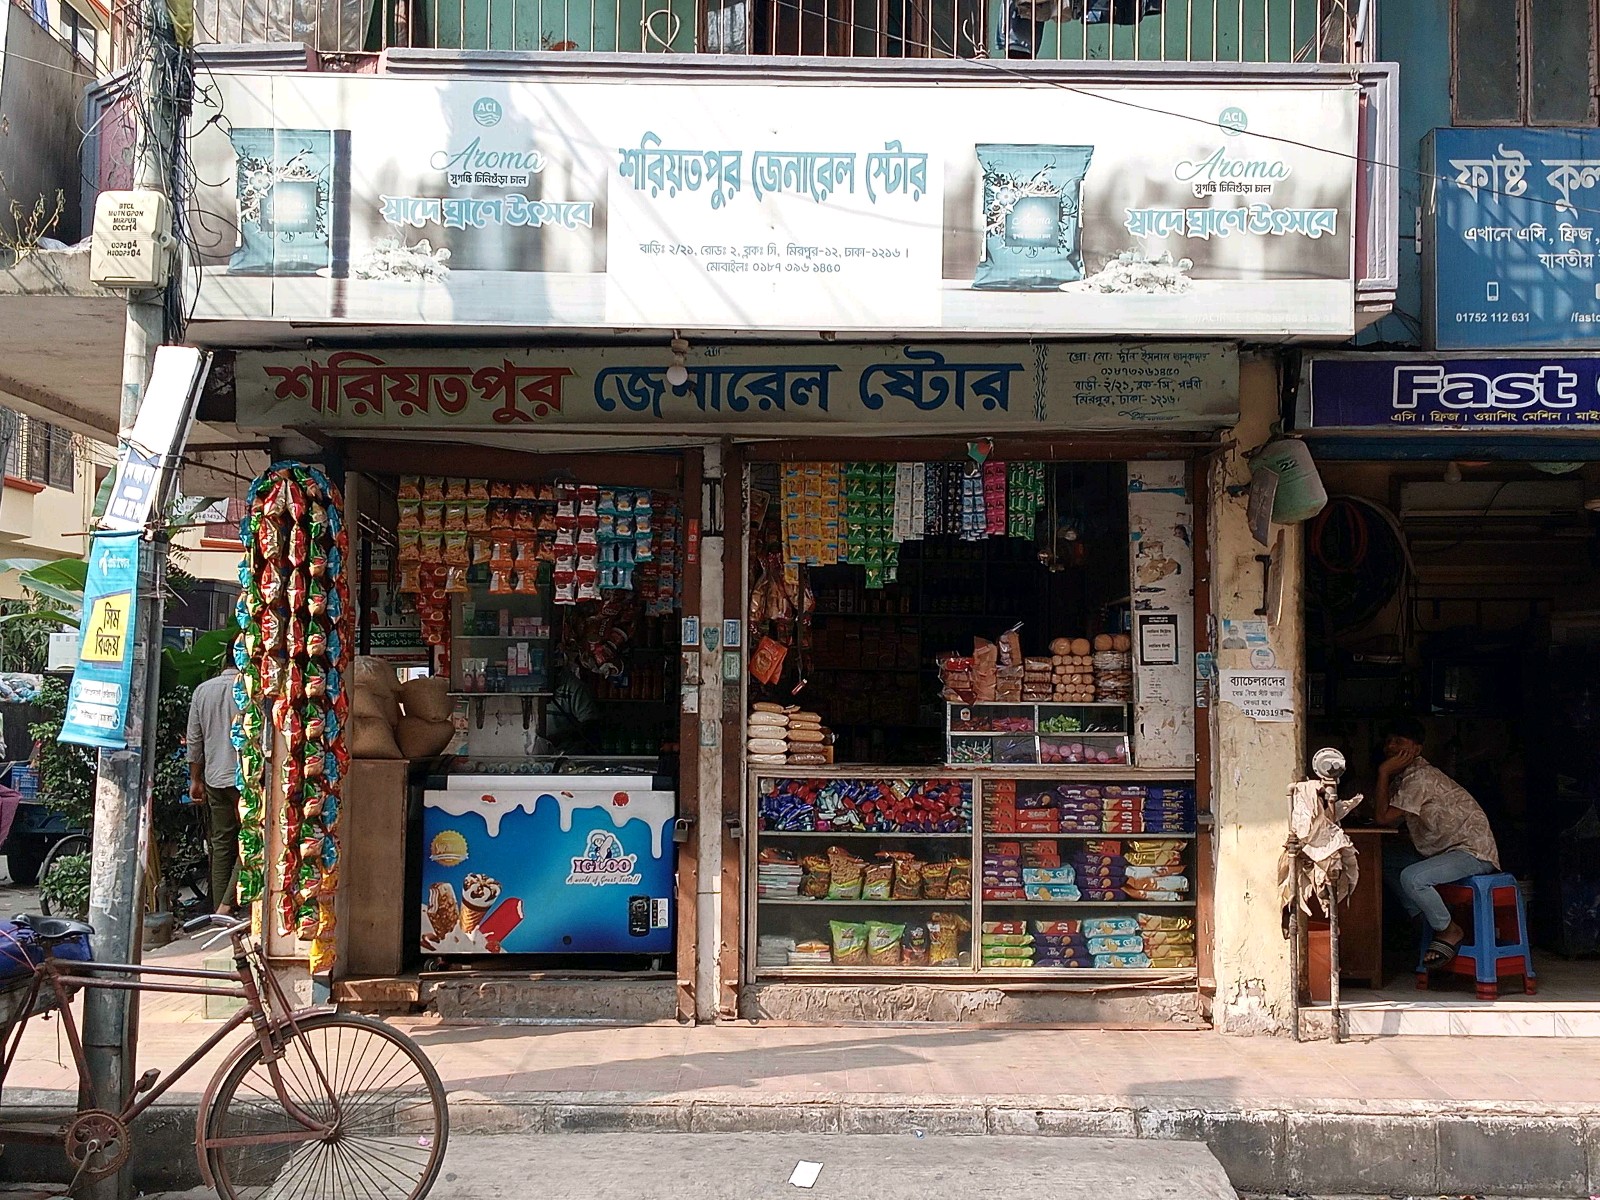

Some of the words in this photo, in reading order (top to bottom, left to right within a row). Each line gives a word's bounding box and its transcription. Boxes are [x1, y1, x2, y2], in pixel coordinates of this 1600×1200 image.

[477, 102, 496, 112] ACI
[1223, 112, 1242, 122] ACI
[430, 136, 545, 171] Aroma
[618, 131, 743, 209] শরিয়তপুর
[752, 150, 857, 203] জেনারেল
[865, 139, 928, 204] স্টোর
[1174, 146, 1290, 181] Aroma
[450, 172, 473, 186] সুগন্ধি
[510, 175, 526, 185] চাল
[1195, 181, 1217, 196] সুগন্ধি
[1254, 184, 1271, 194] চাল
[381, 197, 440, 226] স্বাদে
[443, 197, 502, 230] ঘ্রাণে
[505, 194, 593, 229] উৎসবে
[1127, 208, 1184, 236] স্বাদে
[1186, 207, 1247, 240] ঘ্রাণে
[1250, 204, 1337, 239] উৎসবে
[1464, 225, 1512, 242] এখানে
[752, 262, 781, 273] ০১৮৭
[784, 262, 810, 273] ৩৯৬
[812, 262, 841, 274] ১৪৫০
[1538, 249, 1594, 269] যাবতীয়
[1456, 312, 1488, 323] 01752
[1490, 312, 1510, 323] 112
[1512, 312, 1530, 323] 631
[262, 351, 577, 424] শরিয়তপুর
[593, 365, 842, 419] জেনারেল
[1392, 366, 1578, 409] Fast
[1391, 410, 1417, 422] এসি
[1429, 410, 1460, 422] ফ্রিজ
[1473, 410, 1517, 422] ওয়াশিং
[1522, 410, 1562, 422] মেশিন
[104, 601, 121, 630] সিম
[94, 627, 121, 656] বিক্রয়
[1230, 676, 1286, 687] ব্যাচেলরদের
[573, 859, 632, 874] IGLOO
